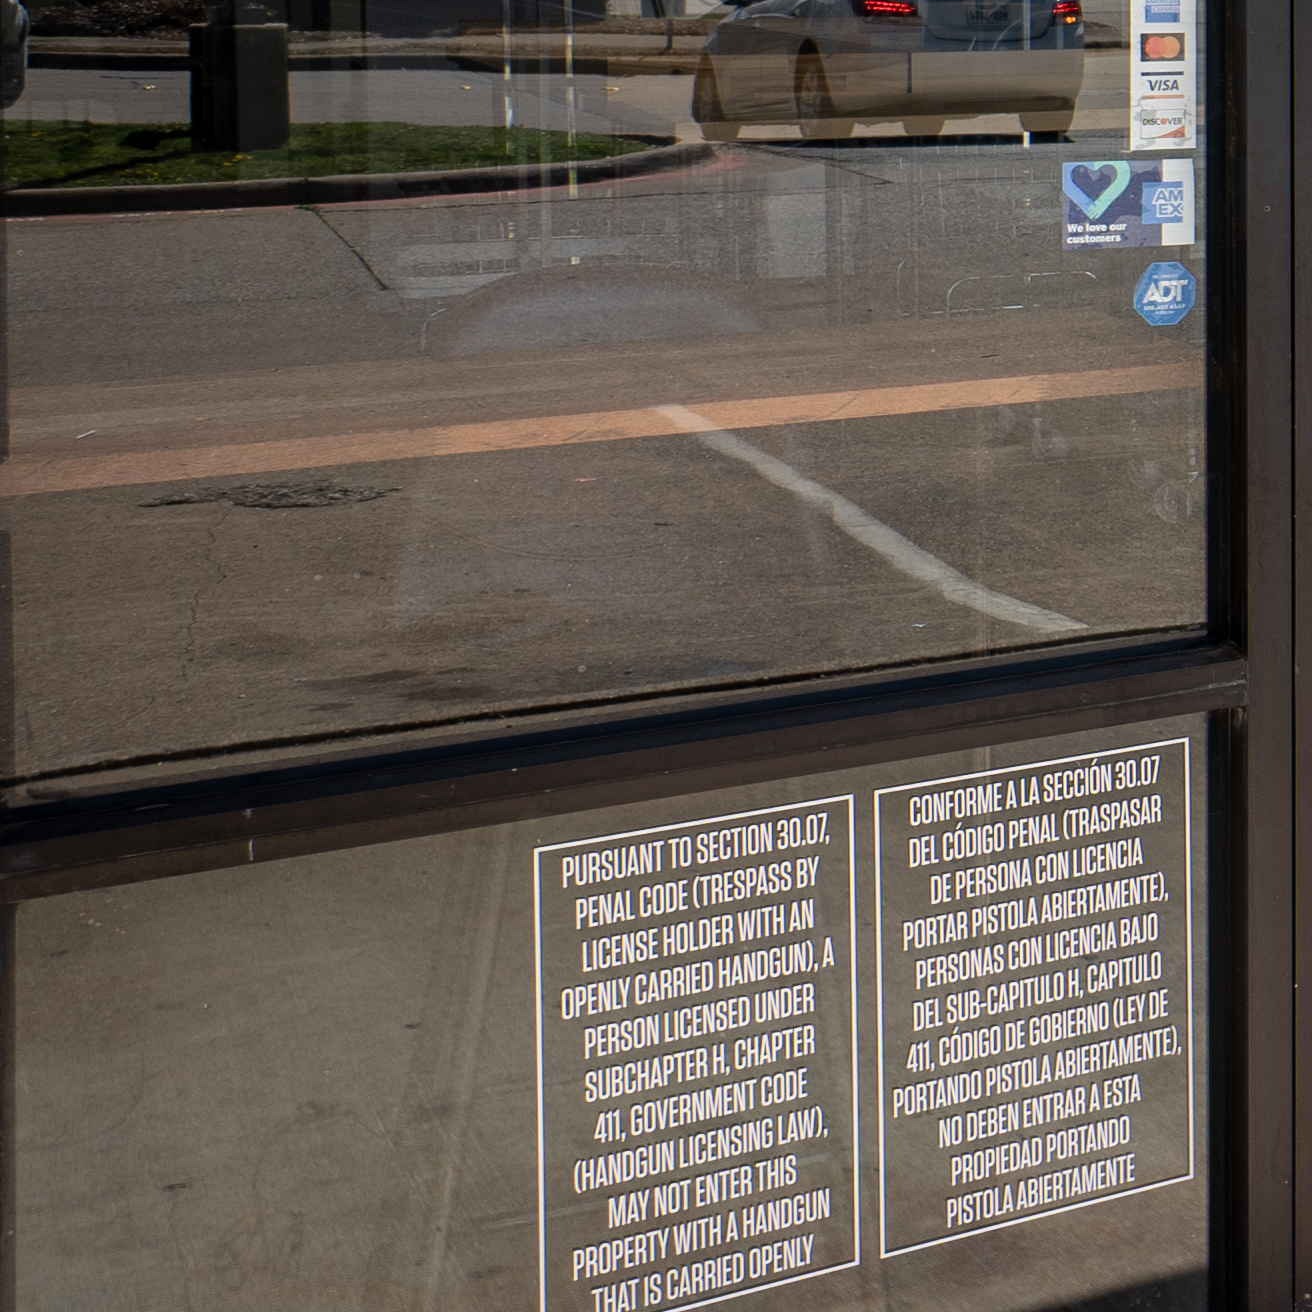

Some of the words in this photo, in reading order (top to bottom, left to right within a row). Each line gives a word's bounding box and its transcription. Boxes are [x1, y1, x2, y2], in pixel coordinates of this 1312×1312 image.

[1147, 79, 1179, 91] VISA
[1067, 224, 1084, 233] We
[1086, 223, 1107, 232] love
[1109, 223, 1128, 231] our
[1153, 189, 1183, 202] AM
[1158, 204, 1183, 215] EX
[1067, 235, 1121, 244] customers
[1142, 279, 1188, 304] ADT
[909, 782, 1002, 826] CONFORME
[1004, 779, 1017, 810] A
[1020, 776, 1040, 807] LA
[1042, 757, 1112, 802] SECCIÓN
[1114, 754, 1160, 789] 30.07
[562, 840, 664, 888] PURSUANT
[667, 836, 692, 869] TO
[696, 821, 772, 864] SECTION
[776, 812, 830, 850] 30.07,
[908, 834, 943, 867] DEL
[944, 816, 1004, 861] CÓDIGO
[1007, 812, 1060, 849] PENAL
[1062, 794, 1161, 840] (TRASPASAR
[575, 889, 636, 929] PENAL
[637, 879, 688, 917] CODE
[692, 861, 792, 908] (TRESPASS
[795, 855, 819, 888] BY
[930, 872, 952, 904] DE
[954, 858, 1032, 900] PERSONA
[1035, 850, 1069, 884] CON
[1072, 837, 1143, 877] LICENCIA
[581, 927, 659, 972] LICENSE
[662, 914, 733, 956] HOLDER
[736, 903, 784, 941] WITH
[788, 898, 814, 932] AN
[903, 910, 968, 951] PORTAR
[971, 896, 1040, 937] PISTOLA
[1040, 871, 1168, 923] ABIERTAMENTE),
[561, 976, 630, 1019] OPENLY
[634, 961, 713, 1005] CARRIED
[717, 940, 818, 988] HANDGUN),
[821, 936, 834, 968] A
[915, 944, 1003, 989] PERSONAS
[1003, 935, 1042, 971] CON
[1045, 920, 1117, 962] LICENCIA
[1119, 912, 1158, 947] BAJO
[584, 1014, 659, 1059] PERSON
[663, 996, 746, 1042] LICENSED
[747, 983, 814, 1023] UNDER
[584, 1047, 708, 1102] SUBCHAPTER
[711, 1043, 730, 1075] H,
[733, 1024, 814, 1069] CHAPTER
[593, 1108, 626, 1143] 411,
[629, 1078, 757, 1135] GOVERNMENT
[760, 1067, 807, 1106] CODE
[573, 1140, 674, 1193] (HANDGUN
[678, 1118, 773, 1168] LICENSING
[777, 1105, 828, 1145] LAW),
[607, 1188, 650, 1228] MAY
[653, 1178, 691, 1217] NOT
[694, 1165, 752, 1207] ENTER
[754, 1154, 796, 1192] THIS
[572, 1227, 669, 1279] PROPERTY
[672, 1214, 721, 1255] WITH
[725, 1210, 738, 1242] A
[742, 1188, 830, 1238] HANDGUN
[589, 1278, 641, 1312] THAT
[642, 1273, 662, 1306] IS
[665, 1252, 744, 1299] CARRIED
[748, 1233, 814, 1278] OPENLY
